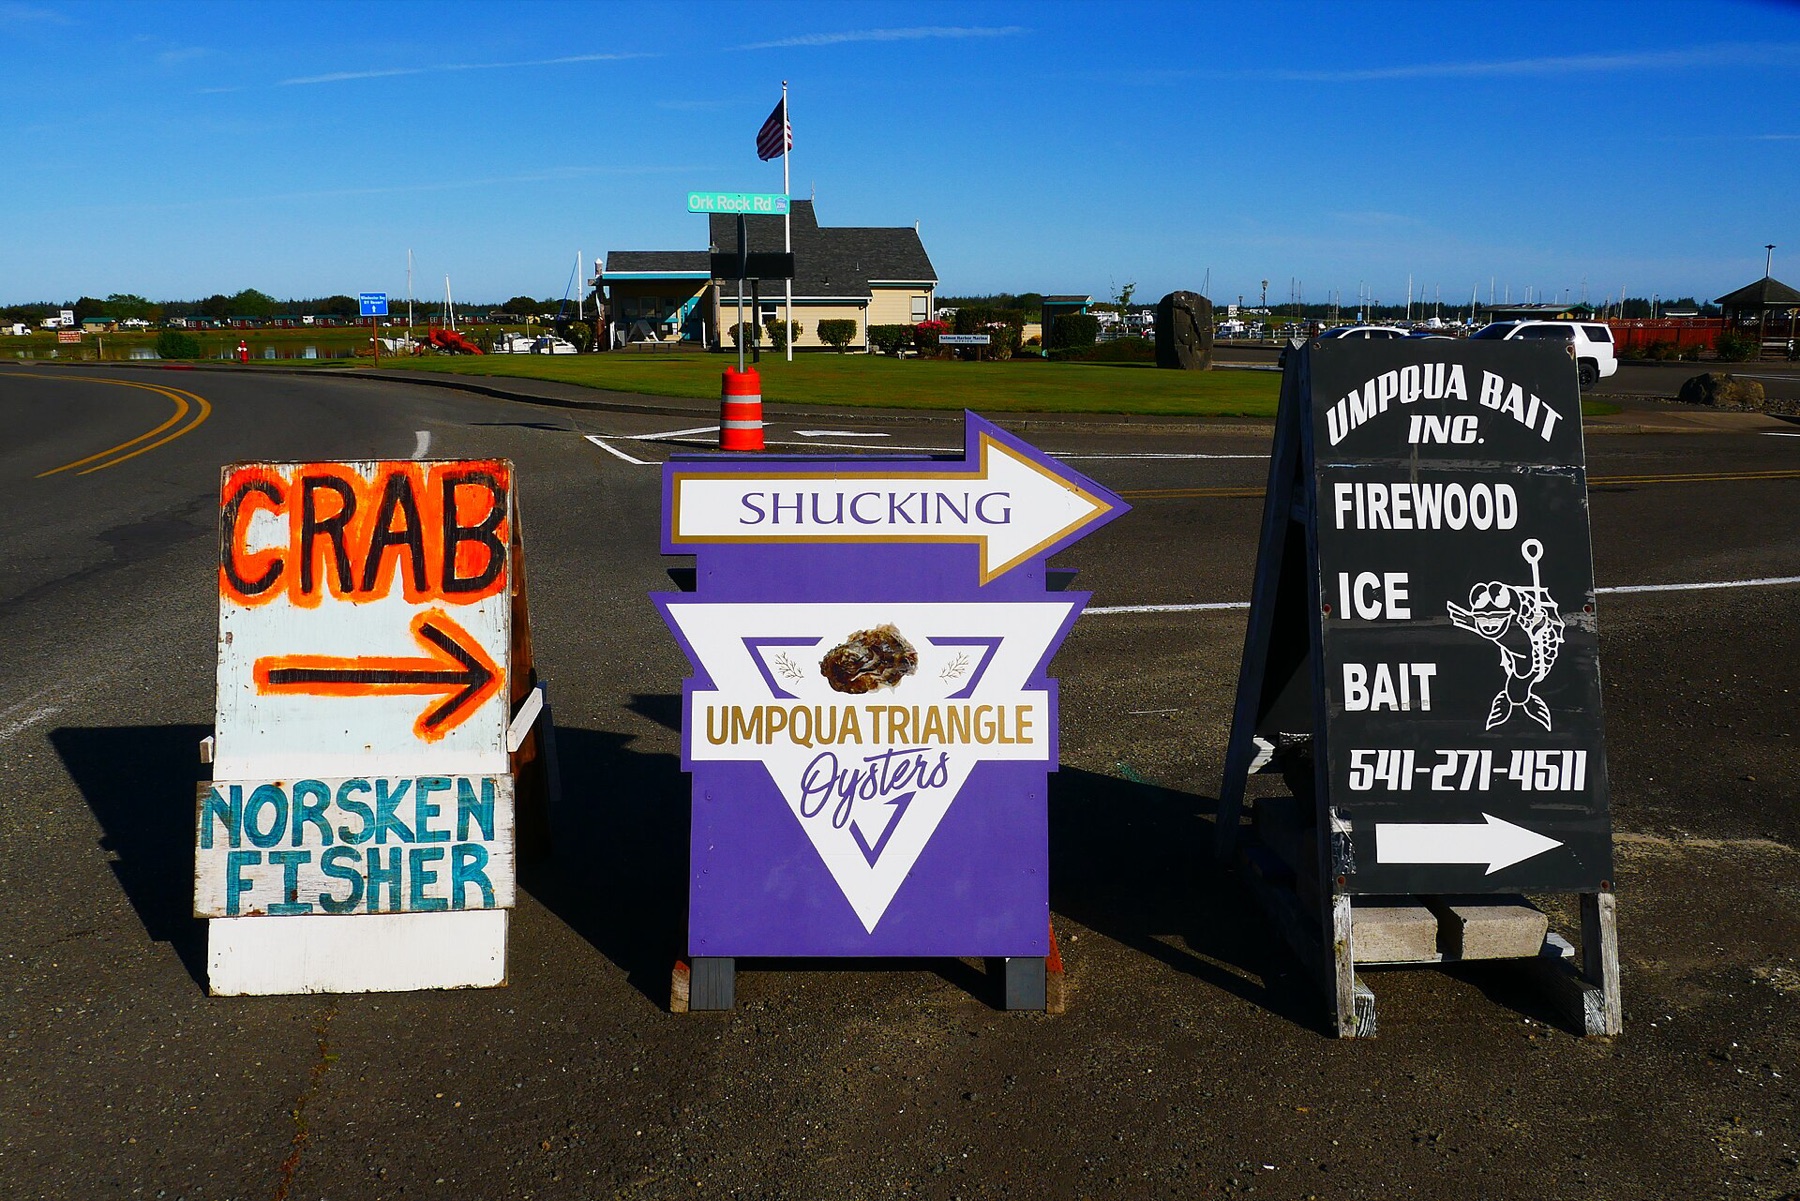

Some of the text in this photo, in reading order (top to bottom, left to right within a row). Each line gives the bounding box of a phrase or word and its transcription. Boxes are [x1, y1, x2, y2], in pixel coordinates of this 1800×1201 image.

[690, 194, 714, 210] Ork
[717, 195, 750, 211] Rock
[754, 196, 771, 211] Rd
[1326, 363, 1563, 446] UMPQUA BAIT
[1408, 415, 1485, 444] INC.
[738, 491, 1012, 525] SHUCKING
[1334, 482, 1518, 531] FIREWOOD
[220, 470, 508, 597] CRAB
[1338, 571, 1411, 620] ICE
[1342, 663, 1437, 711] BAIT
[706, 704, 1034, 748] UMPQUA TRIANGLE
[799, 747, 950, 829] Oysters
[1349, 749, 1588, 791] 541-271-4511
[200, 777, 495, 850] NORSKEN
[226, 843, 496, 916] FISHER
